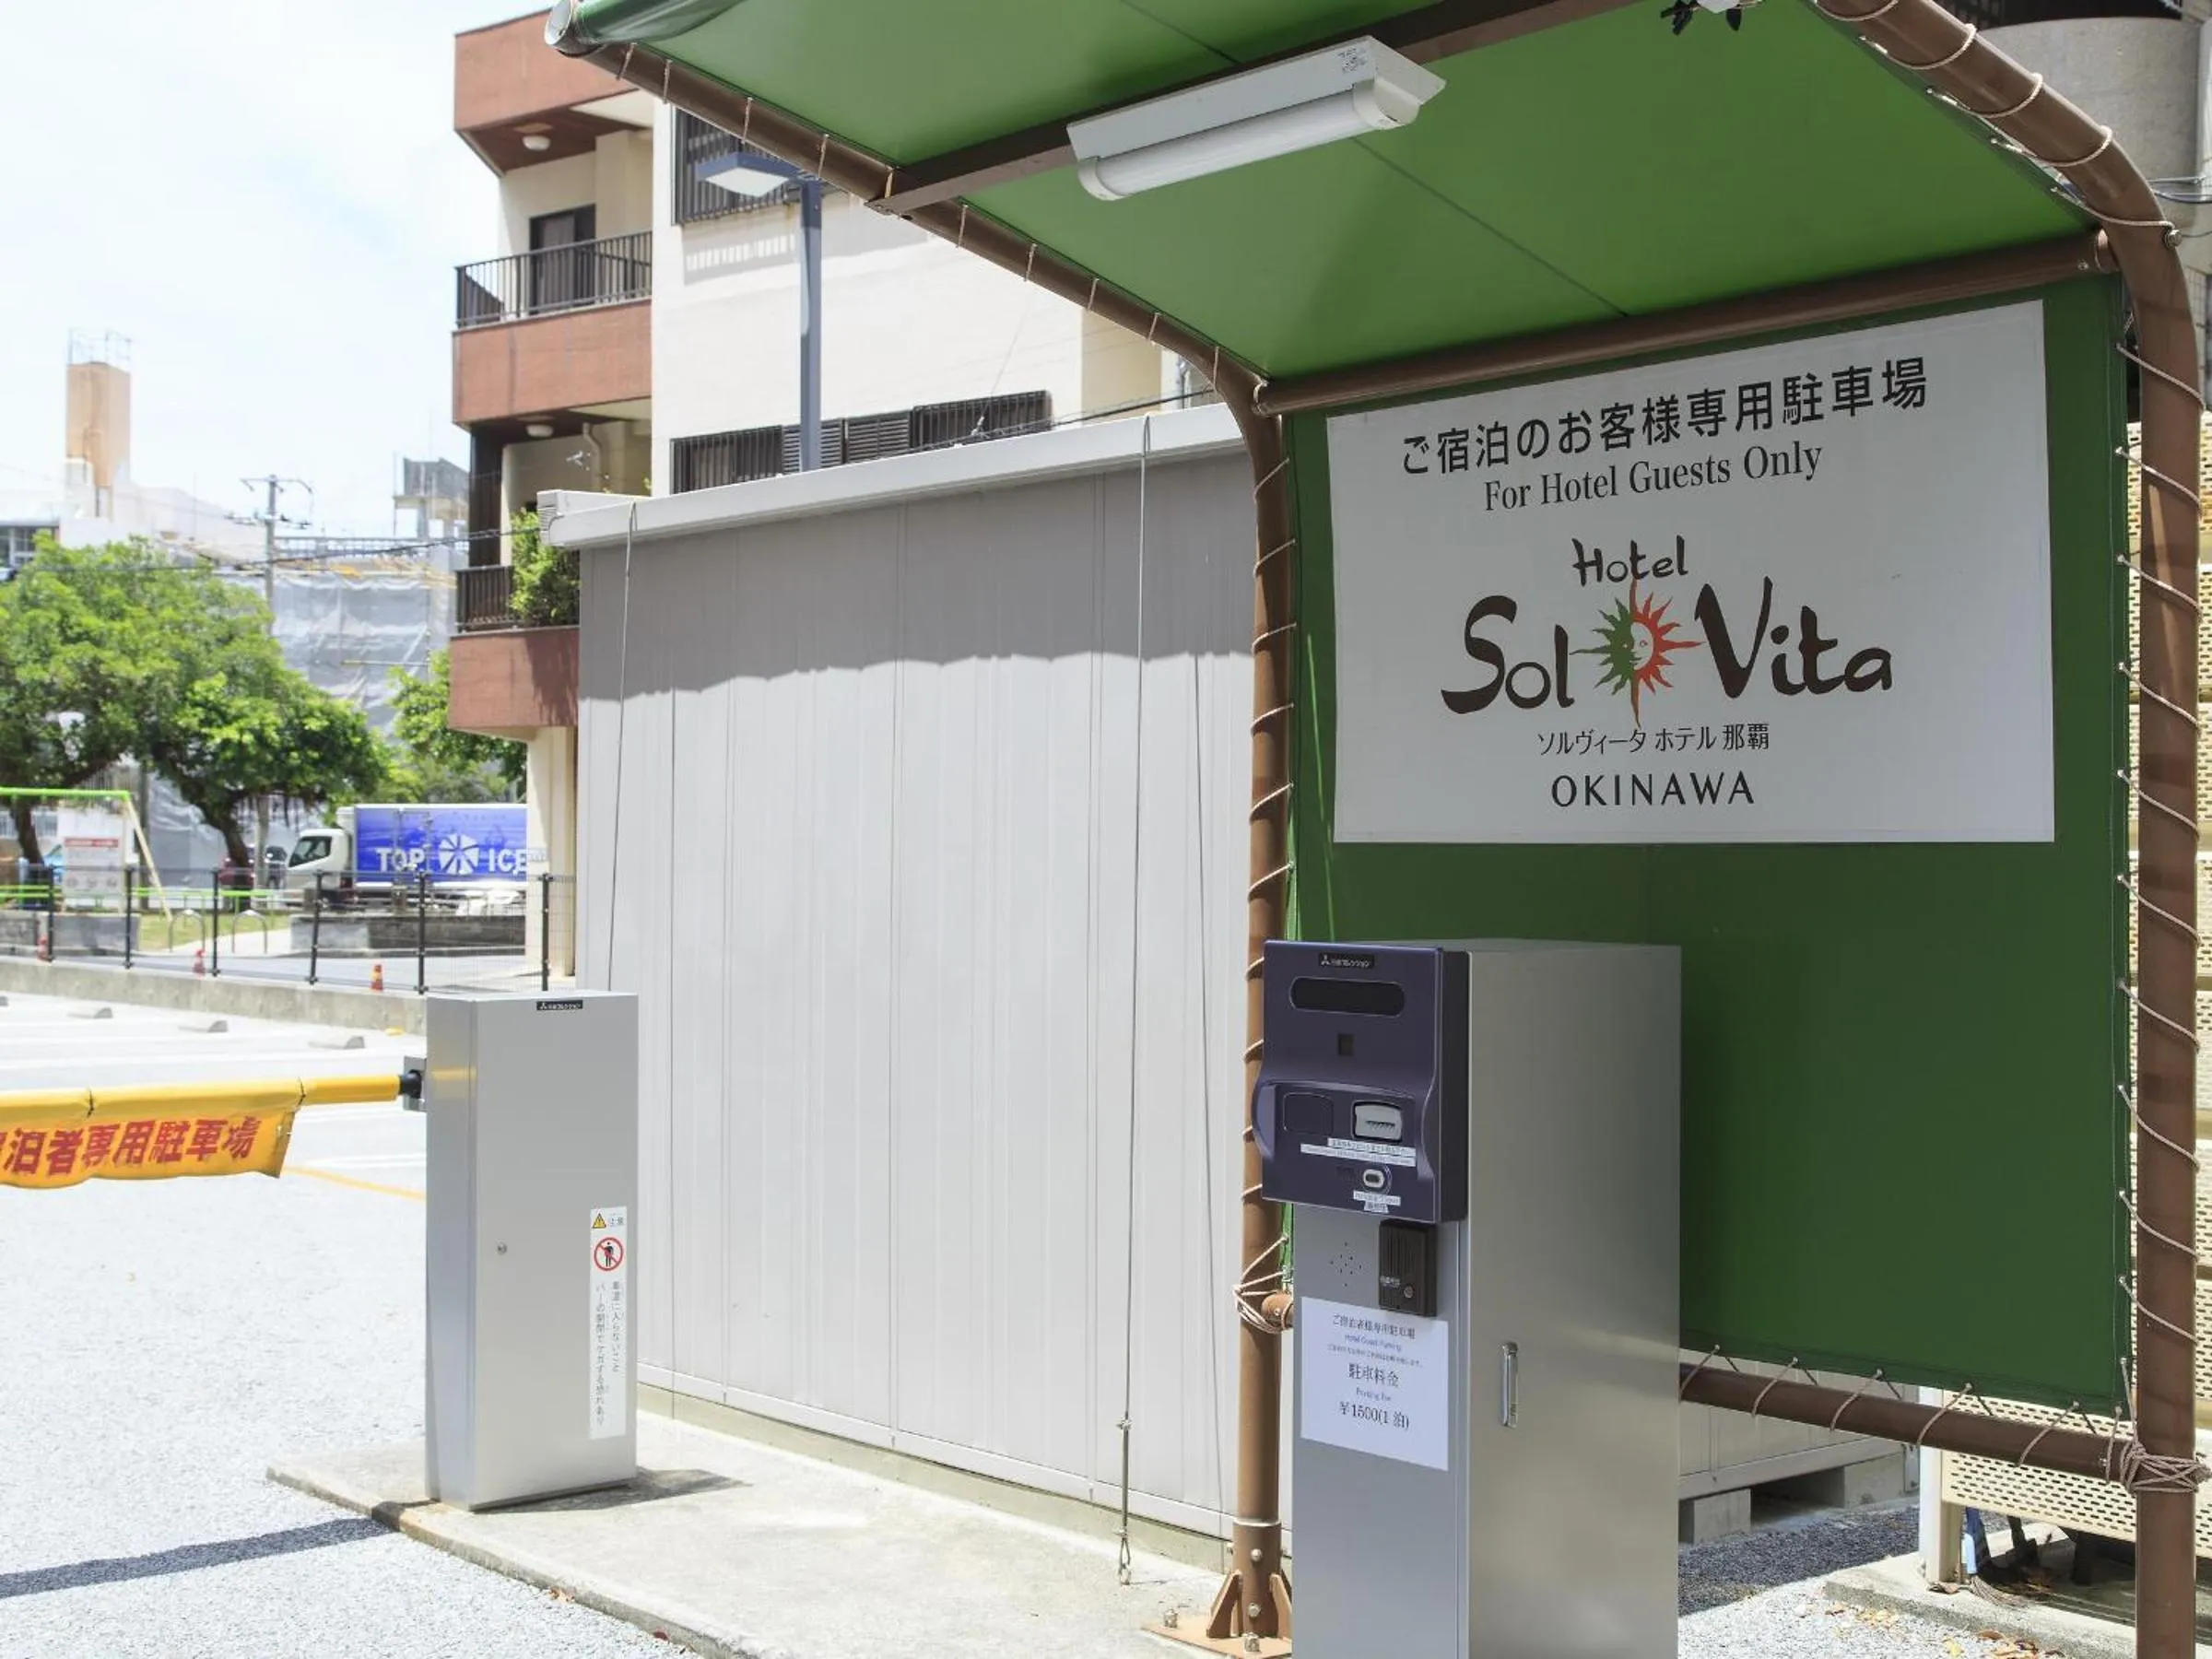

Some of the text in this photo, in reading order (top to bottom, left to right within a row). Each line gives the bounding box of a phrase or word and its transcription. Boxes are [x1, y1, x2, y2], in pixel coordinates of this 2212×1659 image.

[1403, 356, 1927, 475] ご宿泊のお客様専用駐車場
[1485, 440, 1822, 512] For Hotel Guests Only
[1571, 535, 1688, 587] Hotel
[1441, 576, 1892, 715] Sol Vita
[1537, 723, 1770, 756] ソルヴィータ ホテル 那覇
[1551, 770, 1755, 807] OKINAWA
[375, 846, 528, 874] TOP ICE
